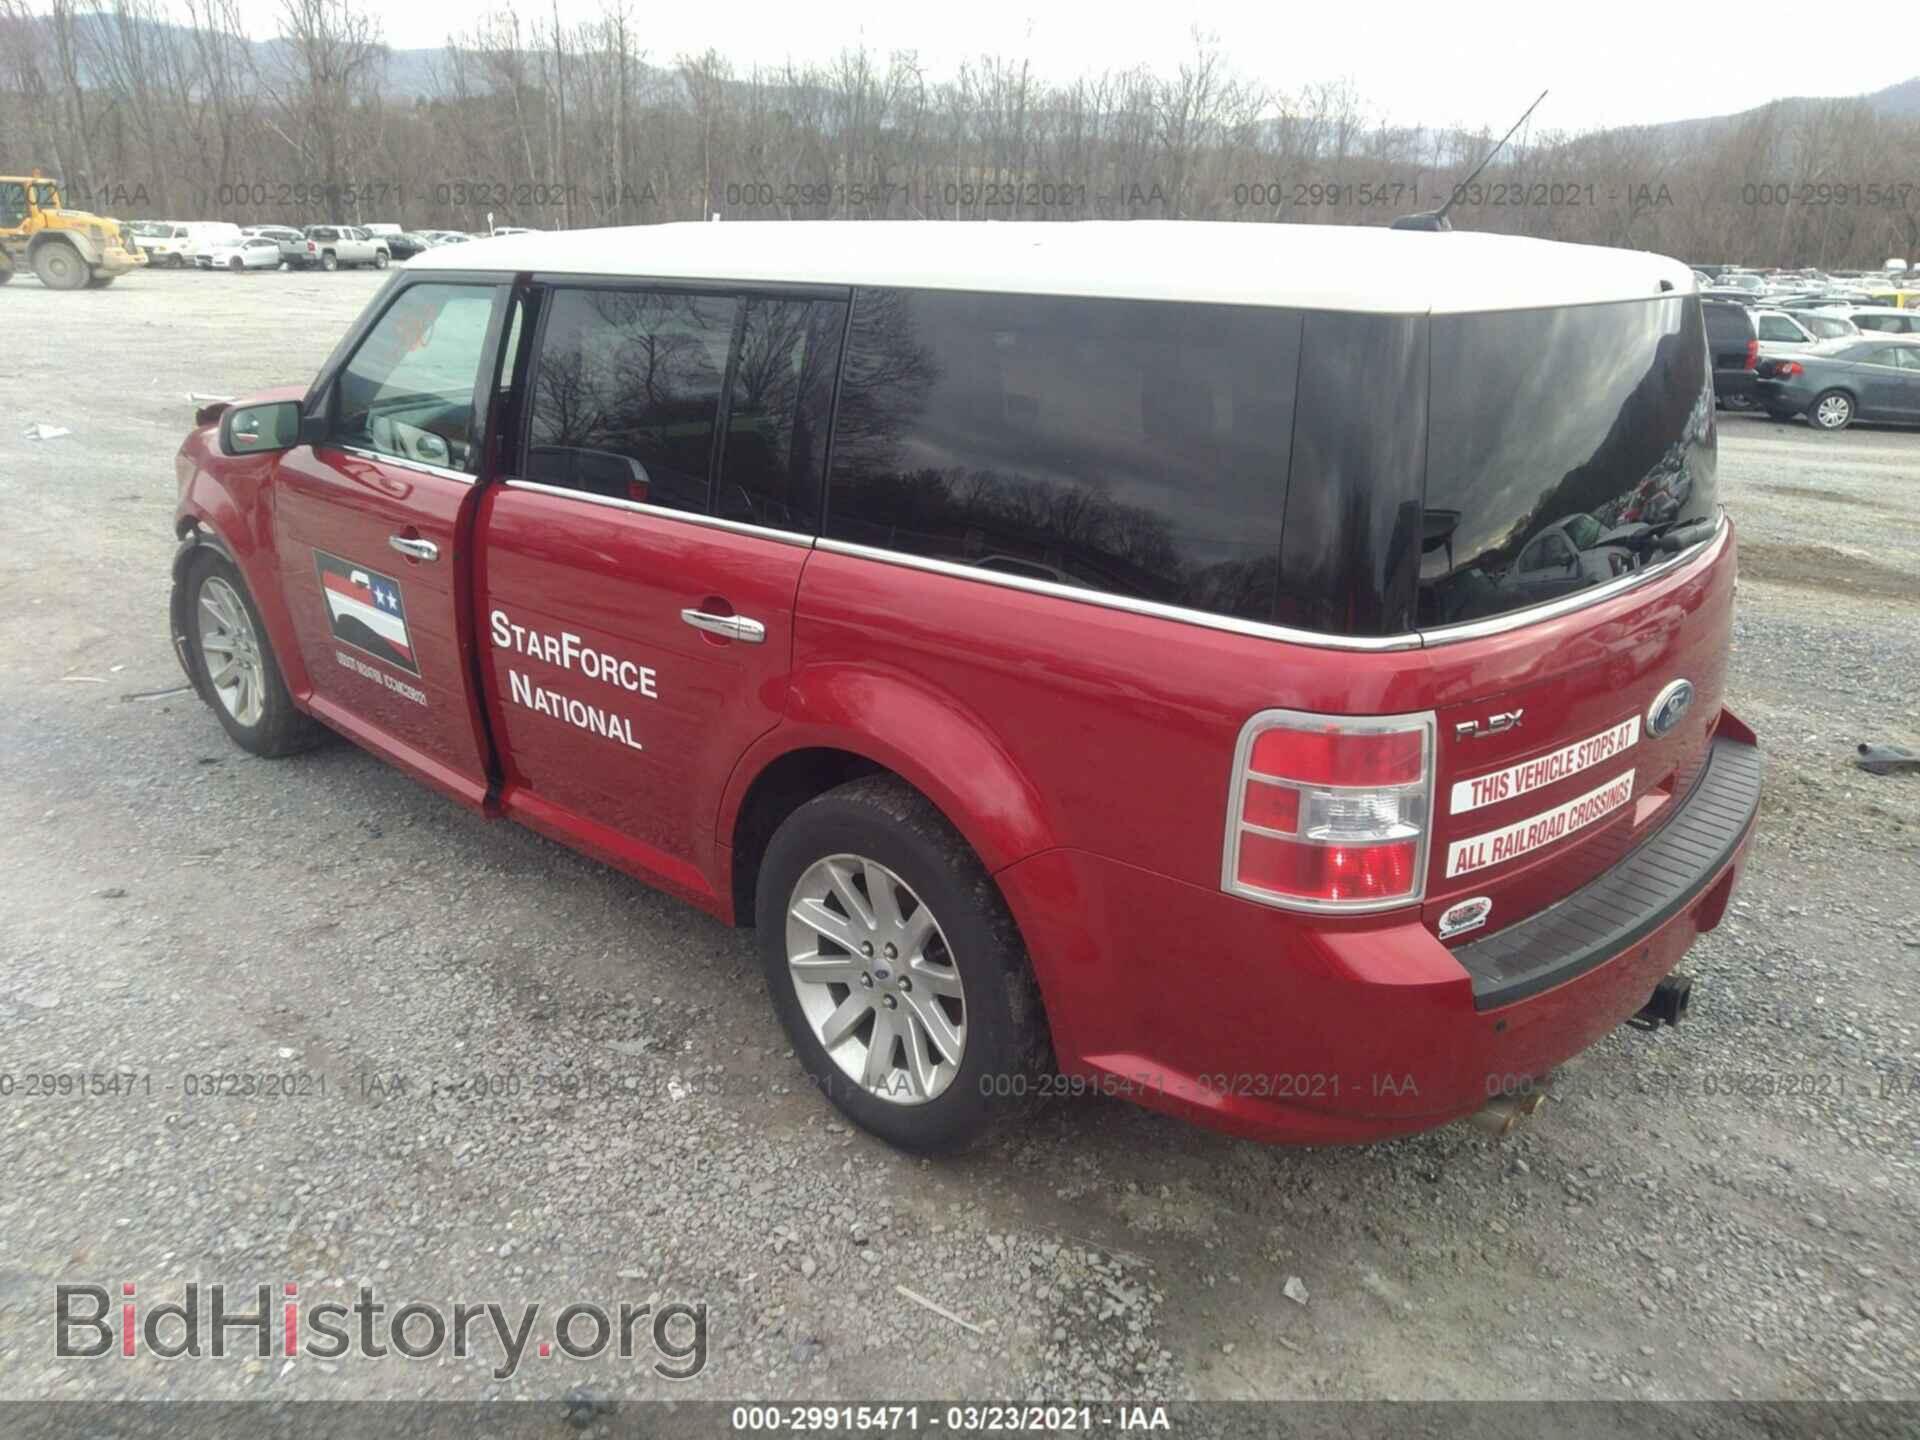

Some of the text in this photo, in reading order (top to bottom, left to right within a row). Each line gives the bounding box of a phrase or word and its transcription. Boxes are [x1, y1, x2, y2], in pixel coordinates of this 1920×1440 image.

[1456, 709, 1524, 742] FLEX
[1471, 723, 1632, 806] THIS VEHICLE STOPS AT
[1454, 779, 1631, 873] ALL RAILROAD CROSSINGS
